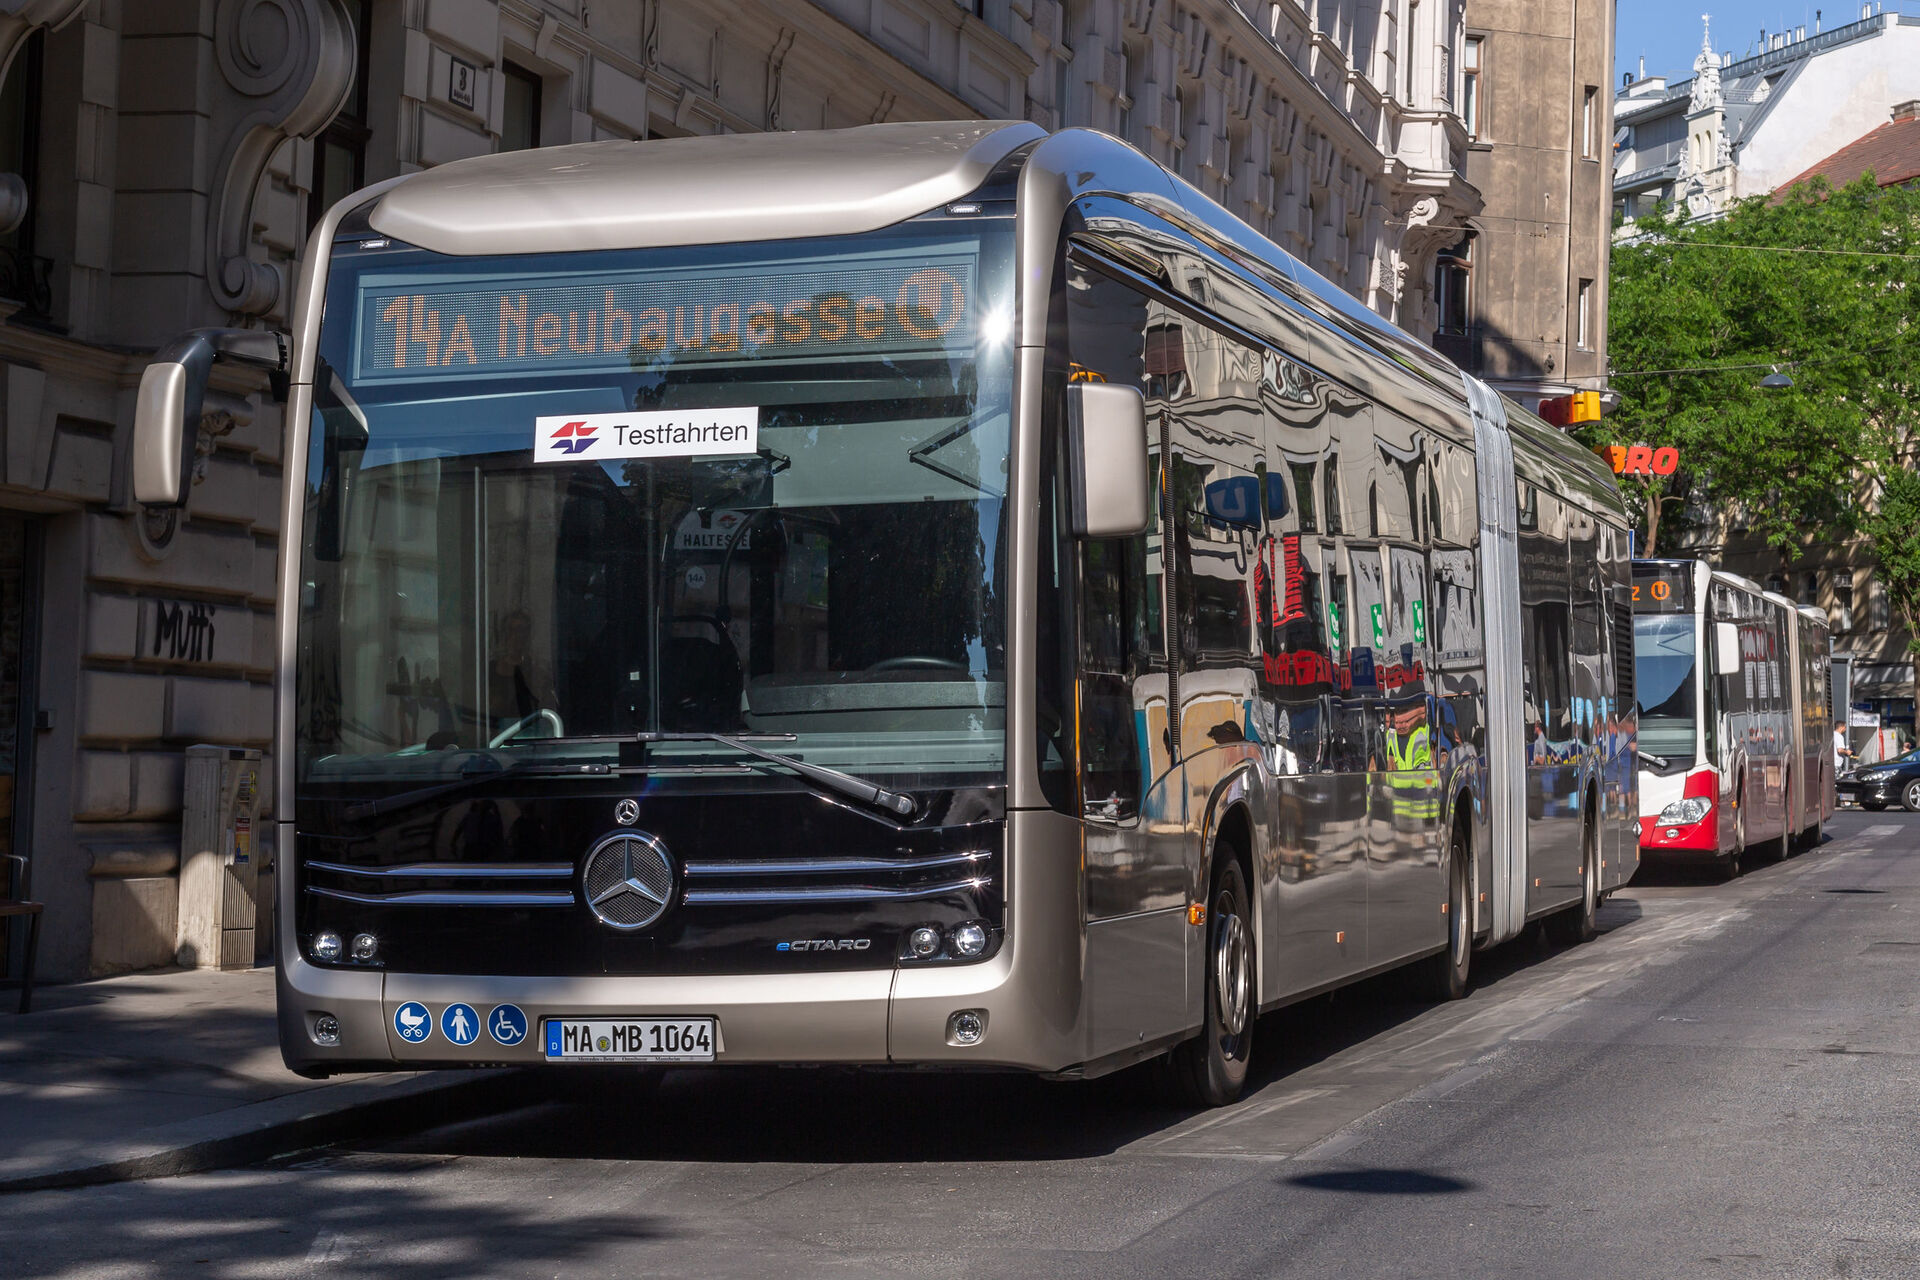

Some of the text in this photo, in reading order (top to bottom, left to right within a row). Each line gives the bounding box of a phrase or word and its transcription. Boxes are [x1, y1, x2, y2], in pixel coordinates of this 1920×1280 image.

[383, 295, 477, 368] 14A
[499, 290, 885, 358] Neubaugasse
[613, 422, 748, 446] Testfahrten
[1603, 445, 1679, 475] BRO
[684, 534, 747, 546] HALTESE
[776, 939, 871, 951] eCITARO
[563, 1025, 593, 1052] MA
[612, 1025, 643, 1052] MB
[650, 1025, 711, 1052] 1064
